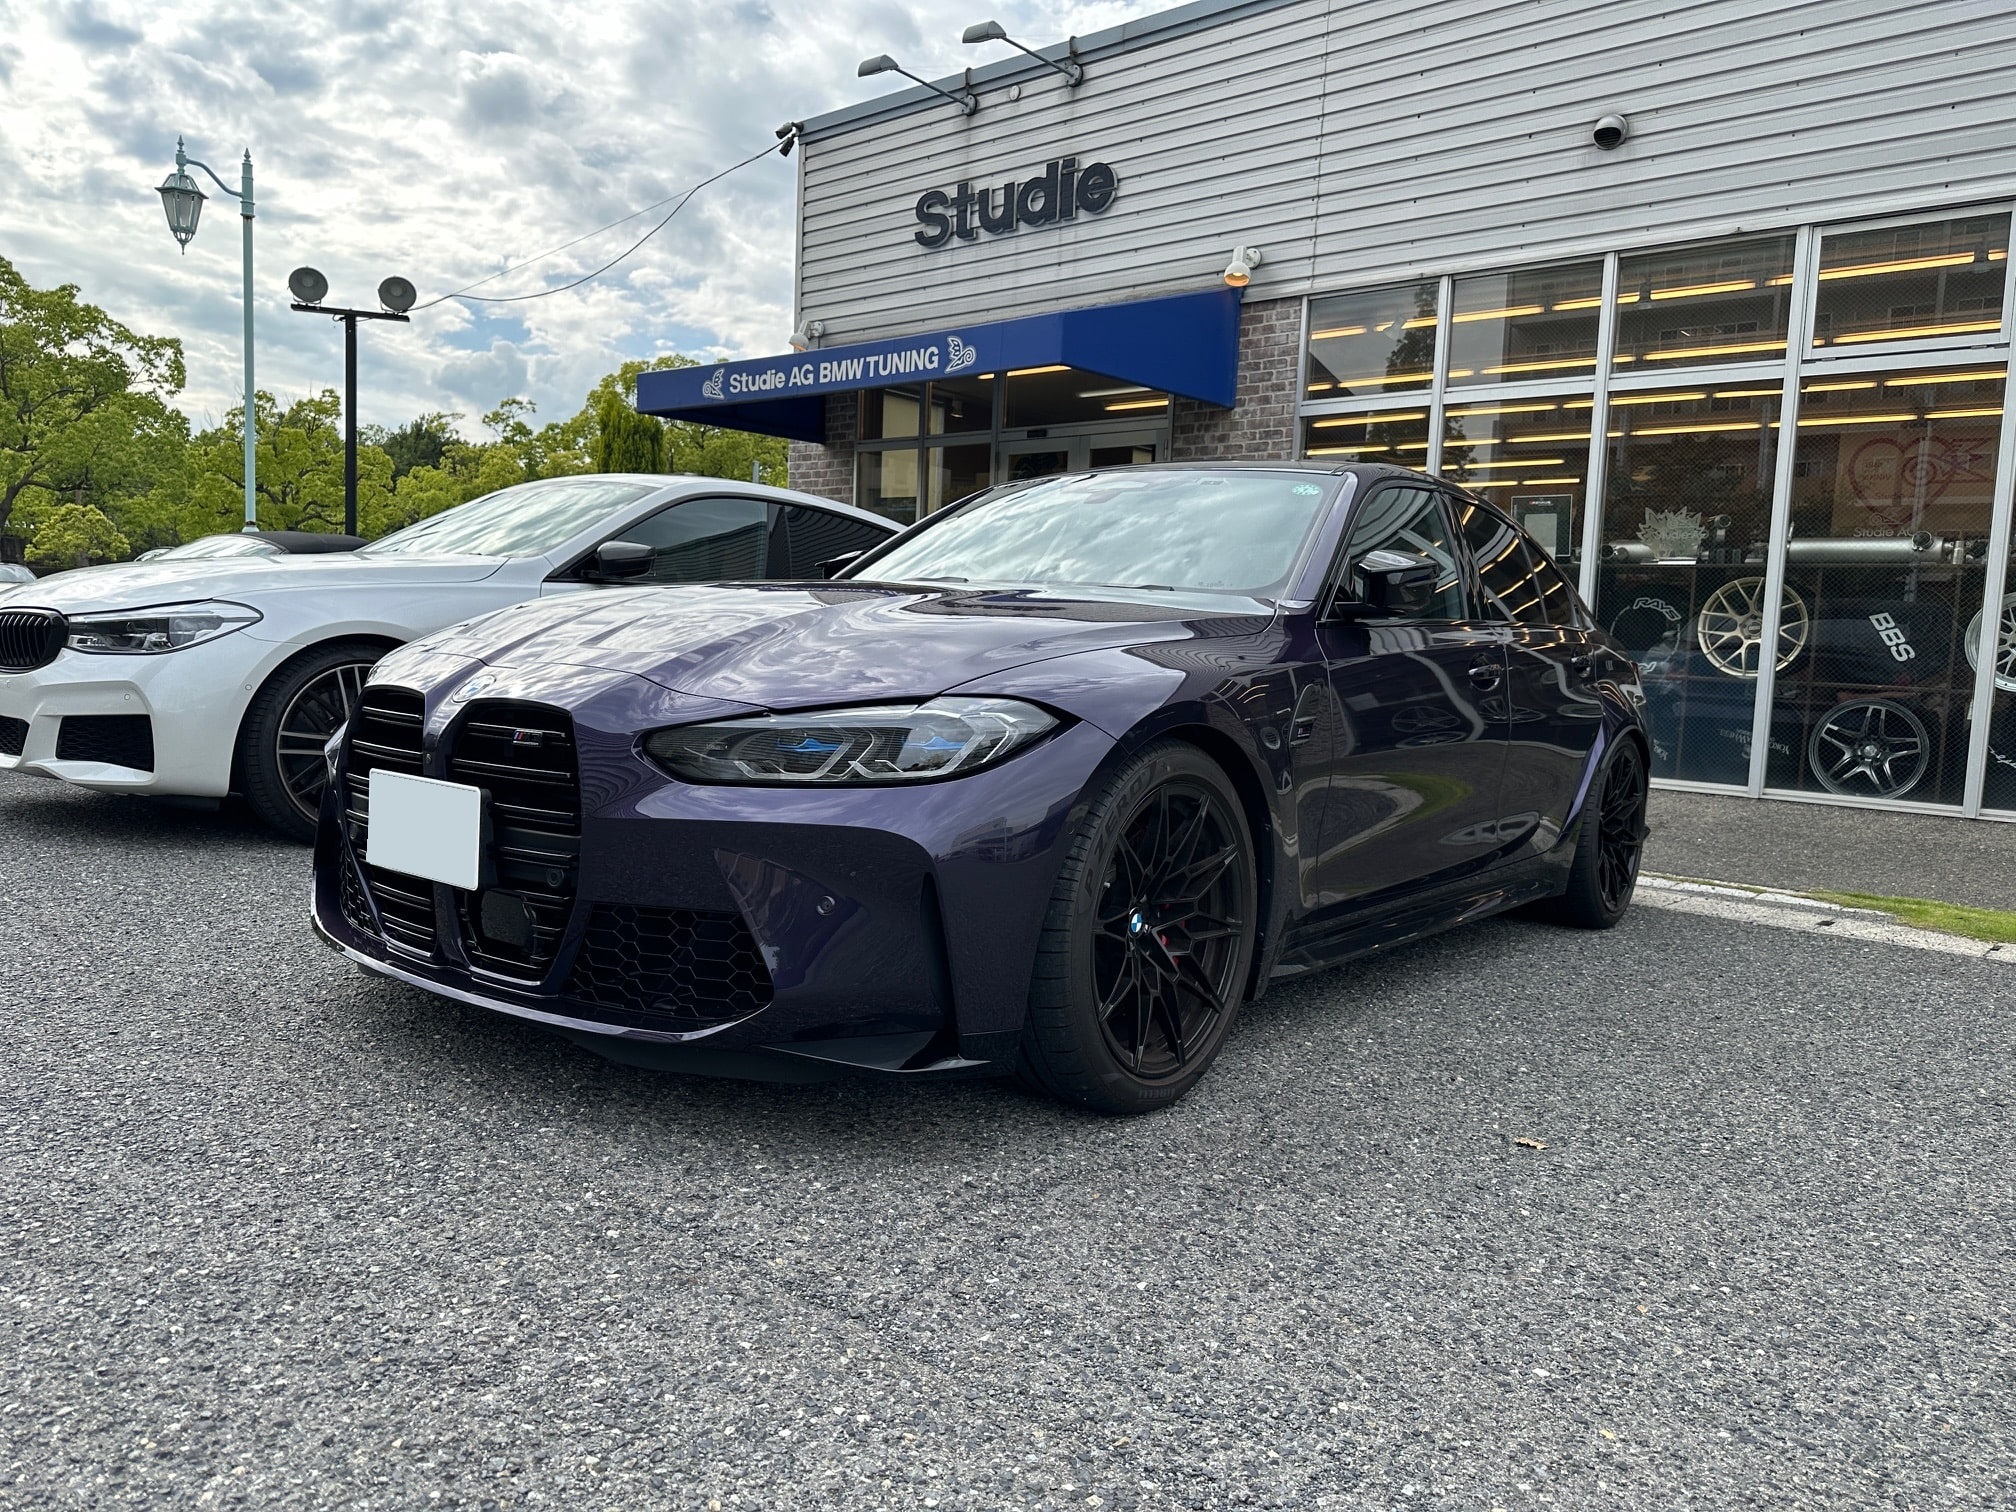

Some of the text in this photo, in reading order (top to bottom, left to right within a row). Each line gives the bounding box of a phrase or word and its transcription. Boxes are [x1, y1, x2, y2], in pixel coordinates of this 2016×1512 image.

[914, 157, 1118, 248] Studie
[729, 347, 938, 393] Studie AG BMW TUNING
[1853, 527, 1894, 538] Studie
[1632, 597, 1682, 622] RAYS
[1869, 612, 1915, 662] BBS
